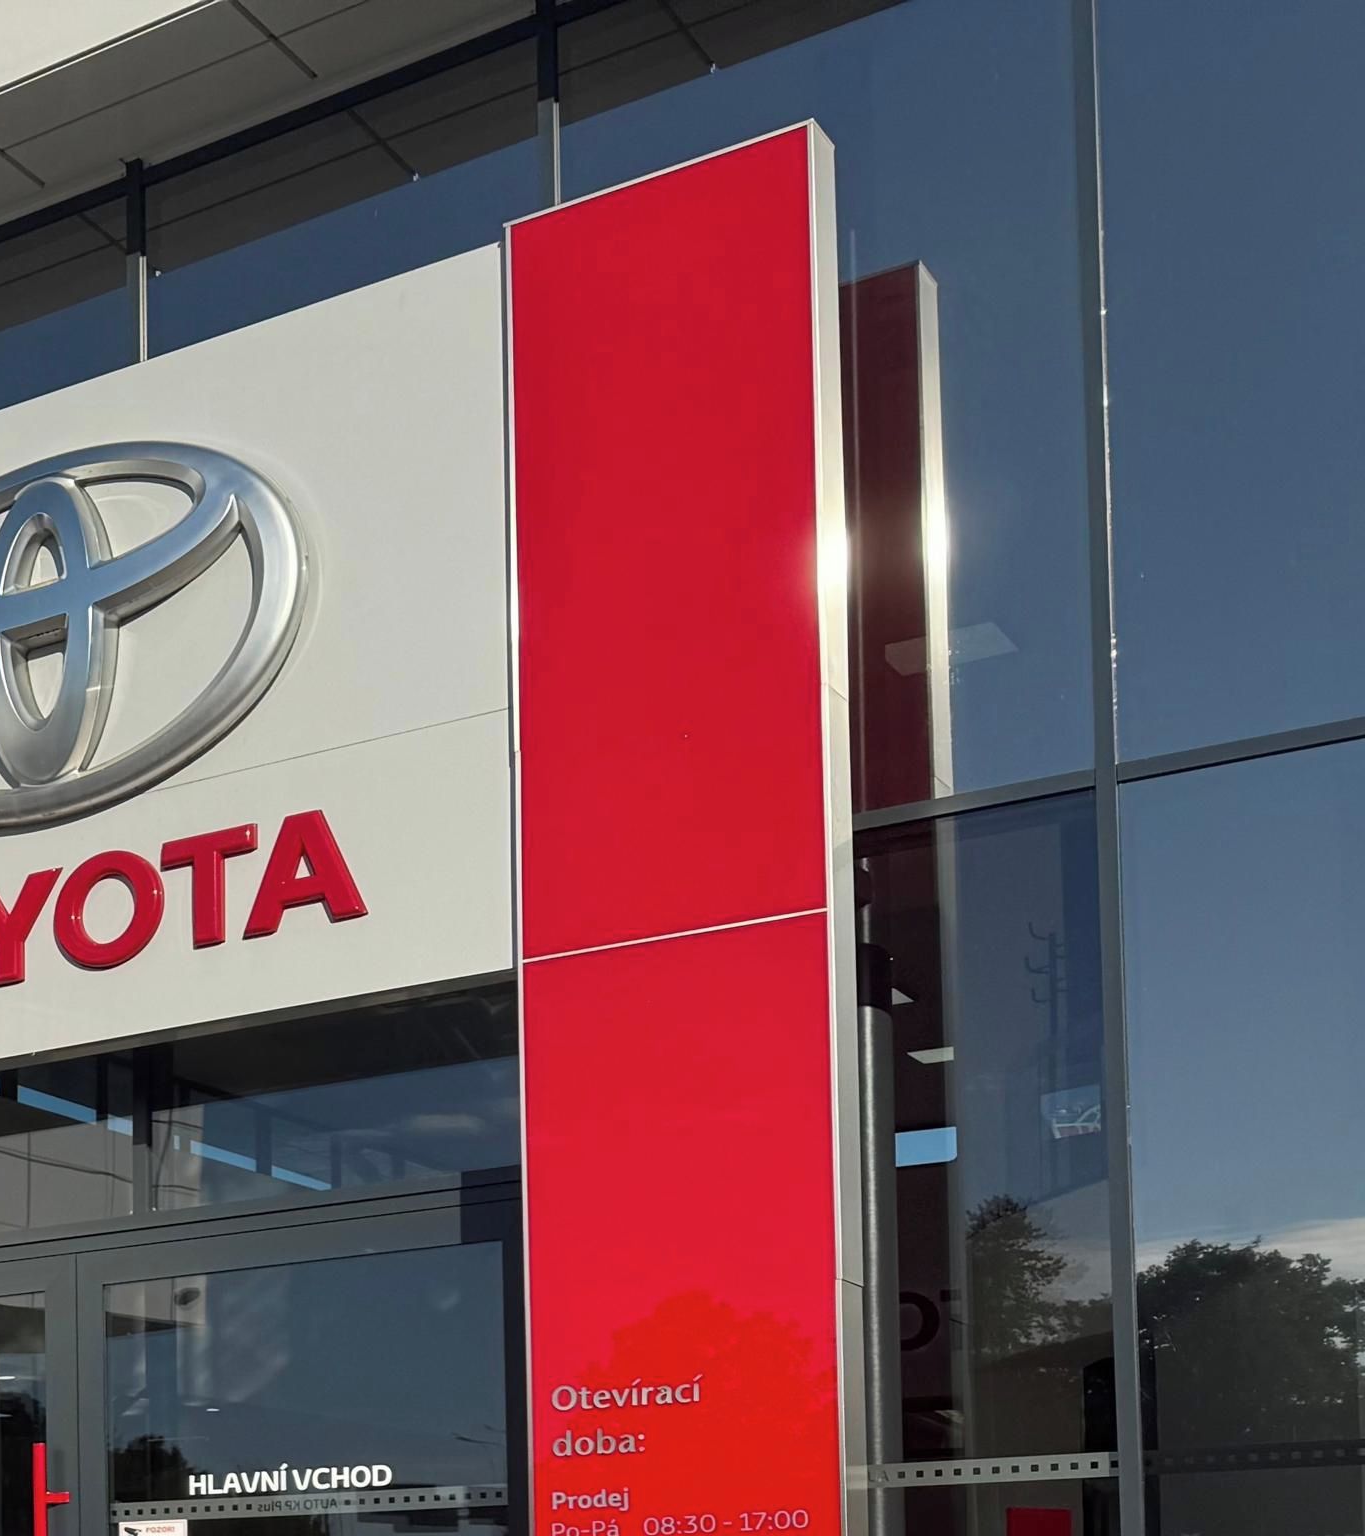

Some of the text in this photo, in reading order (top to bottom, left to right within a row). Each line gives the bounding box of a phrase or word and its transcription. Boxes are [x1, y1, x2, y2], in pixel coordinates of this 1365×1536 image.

[551, 1374, 703, 1411] Otevírací
[552, 1428, 646, 1457] doba:
[188, 1463, 392, 1496] HLAVNÍ VCHOD
[551, 1487, 629, 1511] Prodej
[643, 1514, 716, 1536] 08:30
[739, 1510, 809, 1532] 17:00
